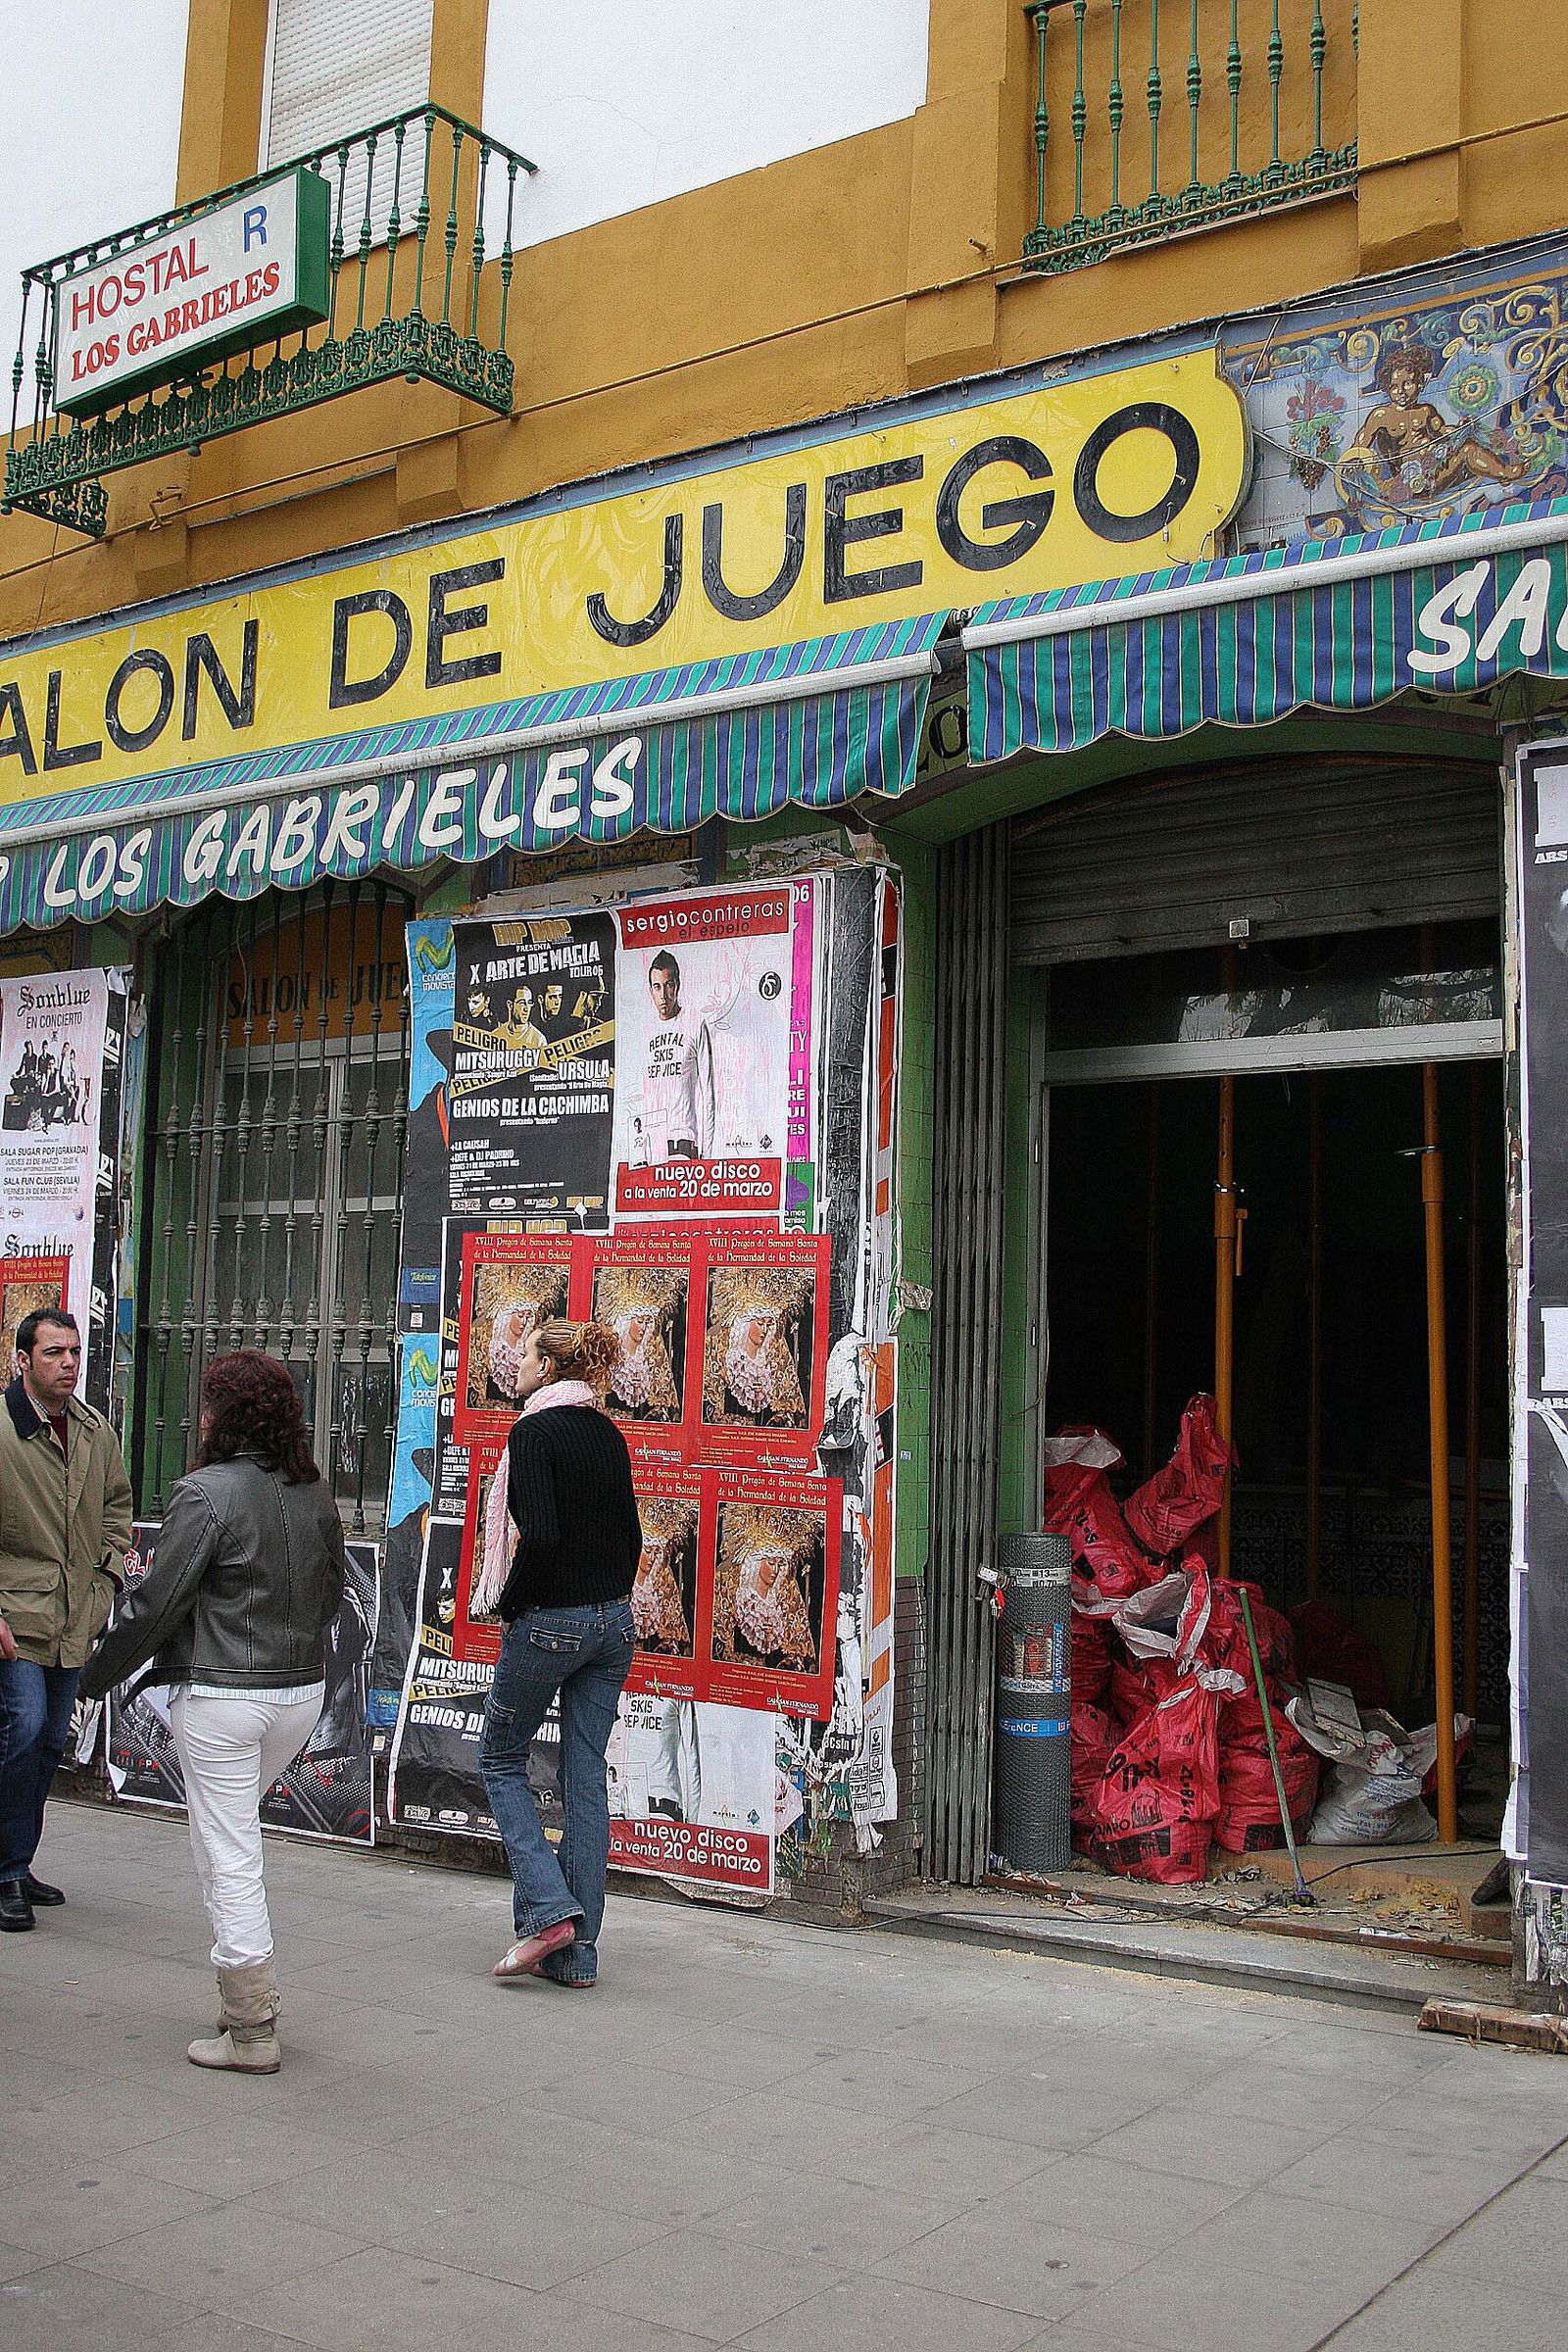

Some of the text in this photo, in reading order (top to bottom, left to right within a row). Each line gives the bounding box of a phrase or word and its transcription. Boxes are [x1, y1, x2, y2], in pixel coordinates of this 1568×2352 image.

[72, 205, 268, 332] HOSTAL R
[72, 261, 281, 381] LOS GABRIELES
[328, 557, 507, 710] DE
[587, 402, 1200, 647] JUEGO
[1407, 559, 1568, 675] SA
[44, 737, 643, 907] LOS GABRIELES
[491, 919, 571, 947] HIP HOP
[516, 942, 552, 953] PRESENTA
[469, 941, 601, 986] X ARTE DE MAGIA
[18, 982, 91, 1017] Sonblue
[26, 1011, 83, 1029] EN CONCIERTO
[457, 1026, 508, 1052] PELIGRO
[649, 1032, 684, 1053] RENTAL
[455, 1049, 541, 1071] MITSURUGGY
[654, 1048, 674, 1062] SKIS
[559, 1058, 611, 1081] URSULA
[453, 1094, 610, 1118] GENIOS DE LA CACHIMBA
[0, 1148, 17, 1156] SALA
[18, 1147, 41, 1155] SUGAR
[655, 1160, 761, 1181] nuevo disco
[3, 1177, 20, 1186] SALA
[624, 1179, 774, 1200] a la venta 20 de marzo
[475, 1236, 493, 1247] XVIII
[595, 1239, 613, 1250] XVIII
[709, 1238, 727, 1248] XVIII
[473, 1250, 481, 1258] de
[483, 1250, 489, 1258] la
[529, 1250, 536, 1259] de
[538, 1250, 545, 1259] la
[593, 1252, 601, 1262] de
[603, 1252, 610, 1262] la
[648, 1252, 656, 1262] de
[658, 1253, 664, 1262] la
[708, 1250, 817, 1262] de la Hermandad de la Soledad
[657, 1482, 663, 1493] de
[666, 1482, 673, 1493] la
[718, 1471, 739, 1484] XVIII
[767, 1476, 776, 1487] de
[778, 1477, 806, 1490] Semana
[717, 1486, 827, 1506] de la Hermandad de la Soledad
[440, 1567, 453, 1590] X
[425, 1629, 452, 1655] PELI
[418, 1656, 496, 1684] MITSURUG
[630, 1699, 653, 1713] SKIS
[410, 1703, 465, 1731] GENIOS
[634, 1822, 748, 1854] nuevo disco
[611, 1838, 761, 1874] la venta 20 de marzo
